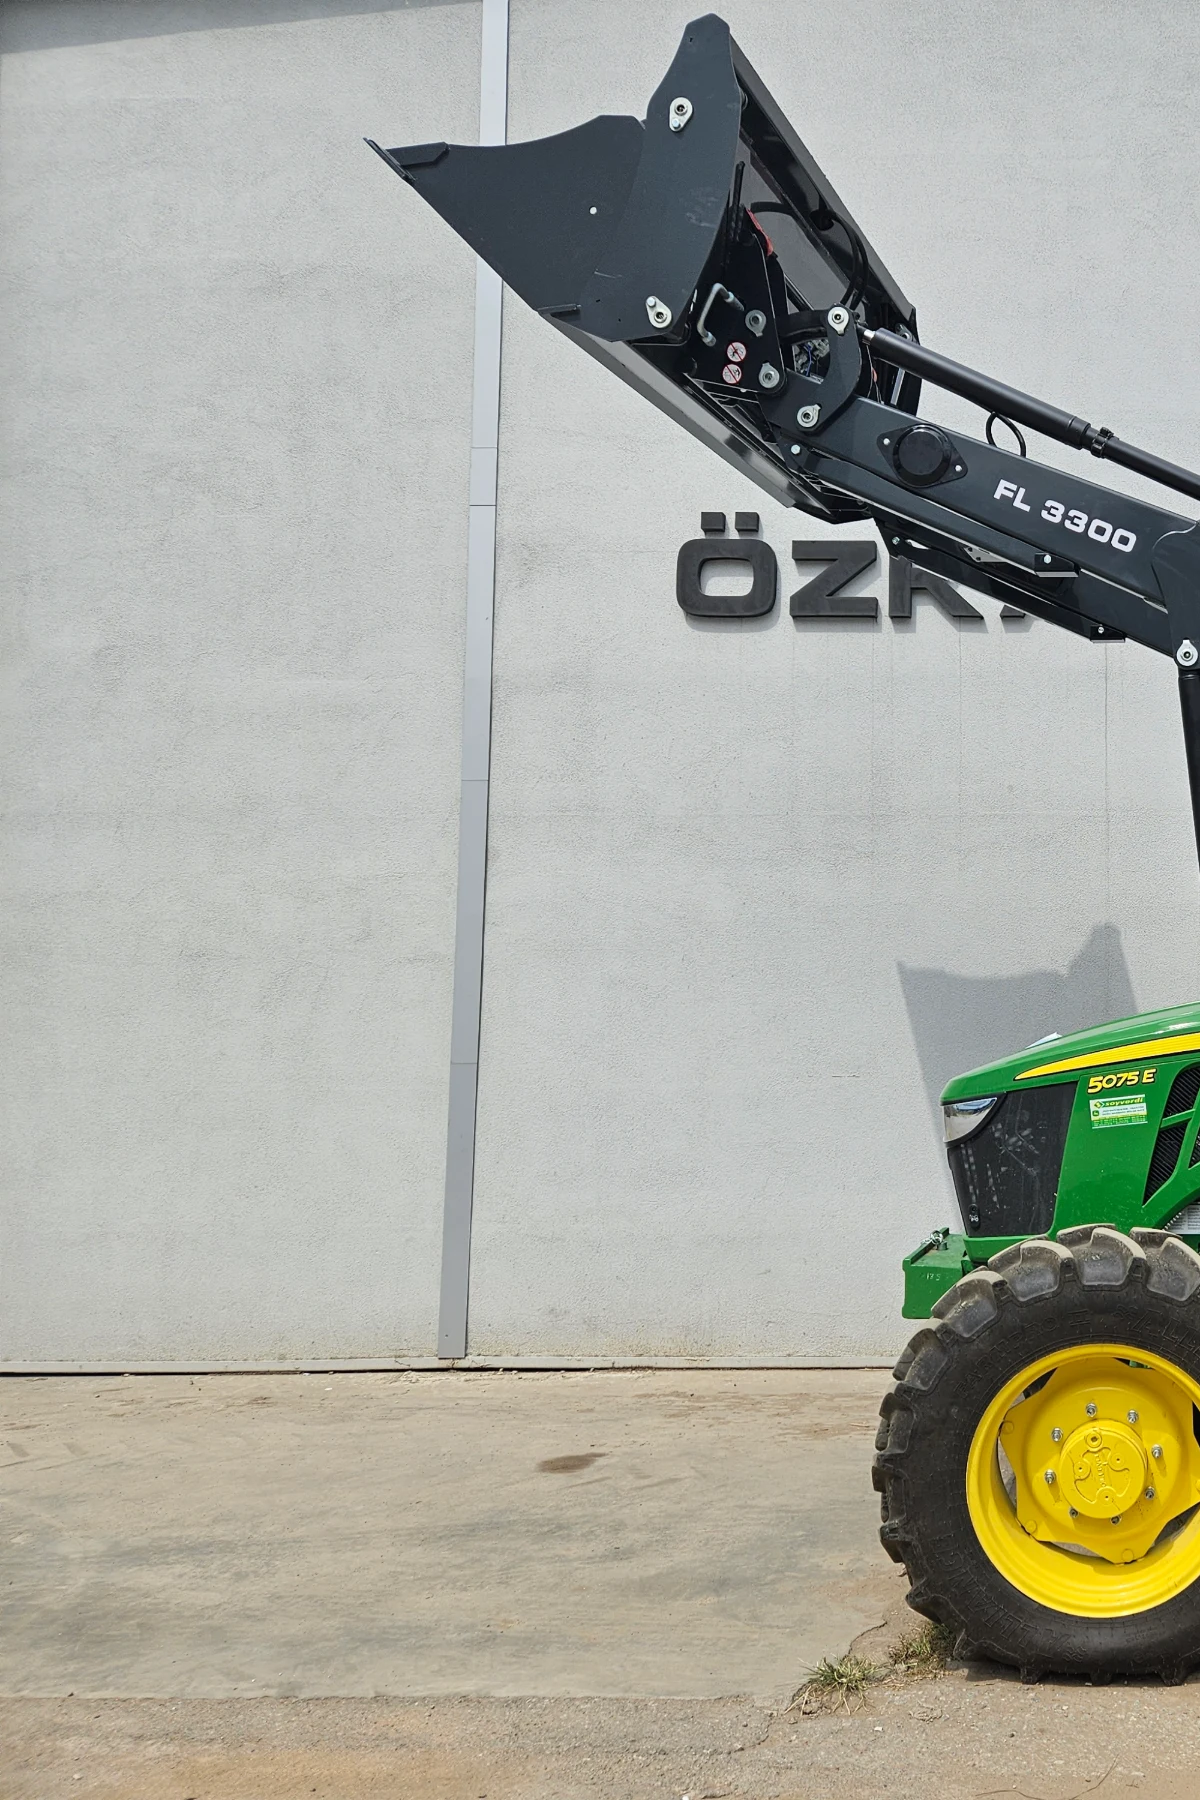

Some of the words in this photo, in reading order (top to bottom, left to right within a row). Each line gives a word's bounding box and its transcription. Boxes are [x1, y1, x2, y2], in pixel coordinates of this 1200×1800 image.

[993, 479, 1031, 512] FL
[1041, 499, 1137, 553] 3300
[1087, 1070, 1140, 1094] 5075
[1142, 1068, 1157, 1084] E
